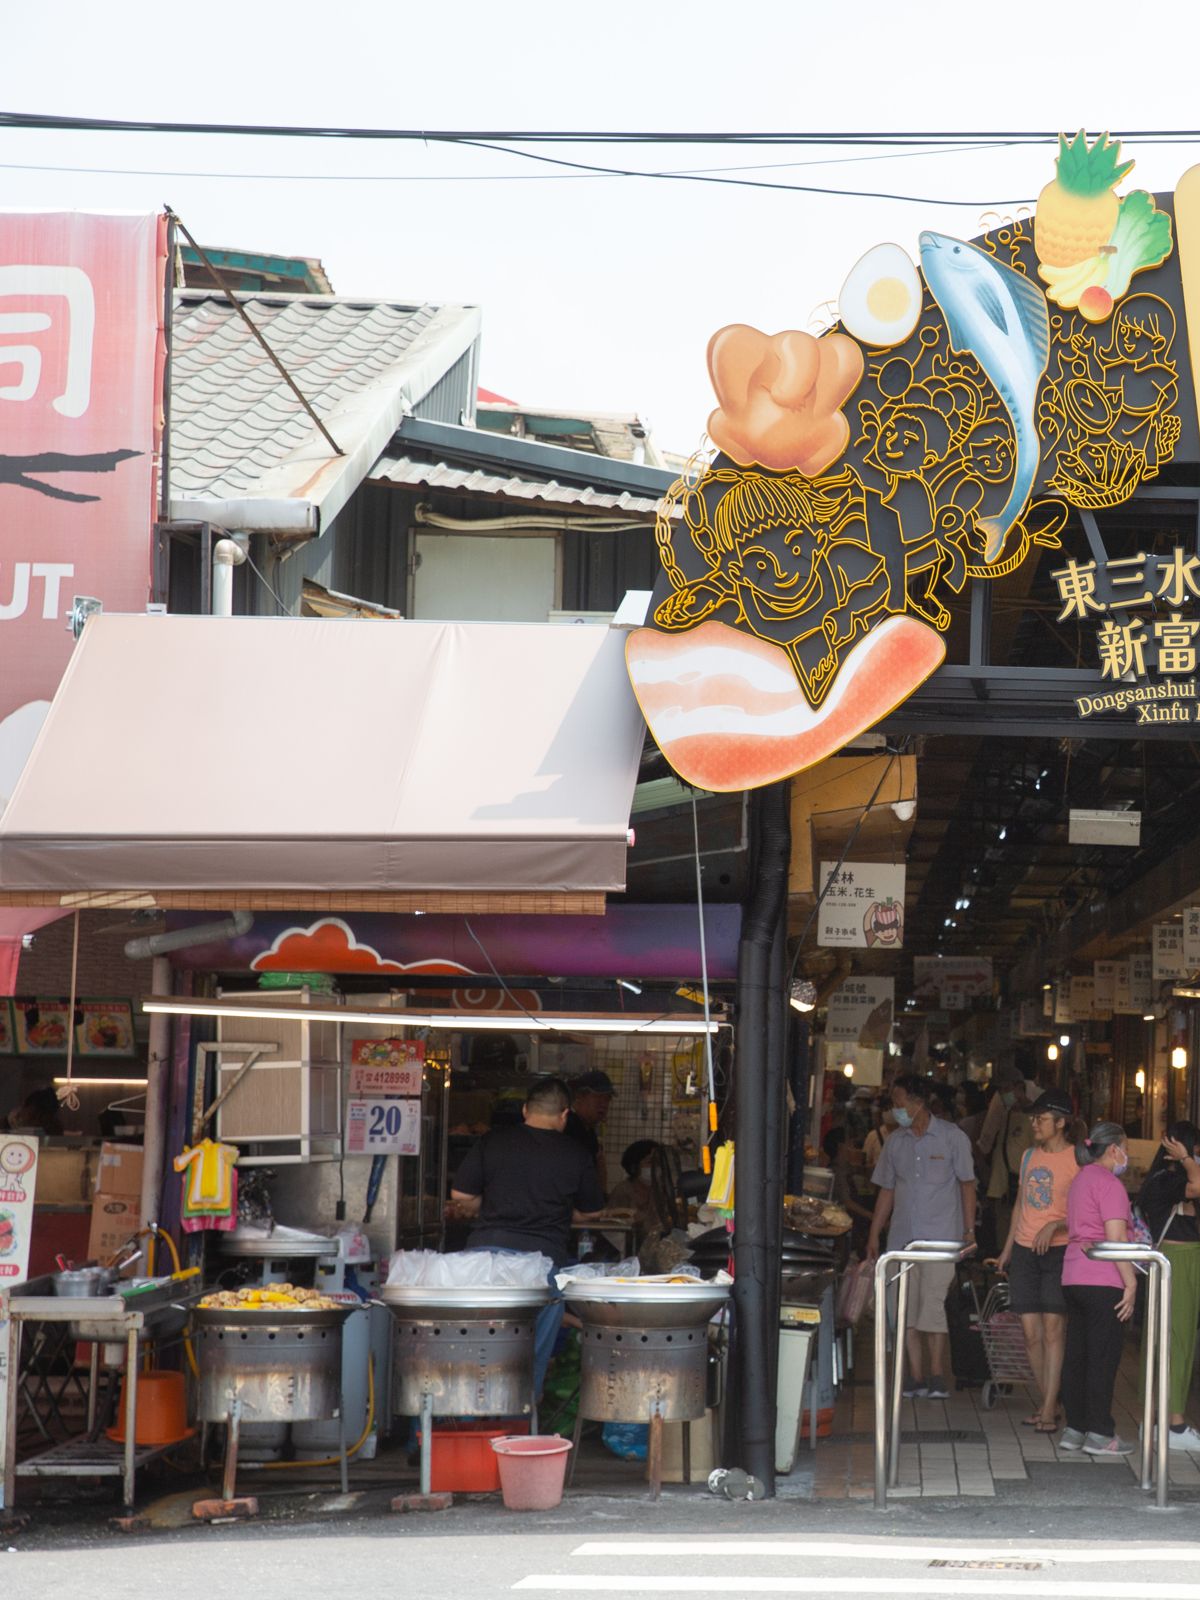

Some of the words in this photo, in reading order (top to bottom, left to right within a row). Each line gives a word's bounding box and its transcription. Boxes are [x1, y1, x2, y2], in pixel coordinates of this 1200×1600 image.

[1076, 679, 1196, 716] Dongsanshui
[1137, 701, 1190, 722] Xinfu
[369, 1105, 403, 1136] 20
